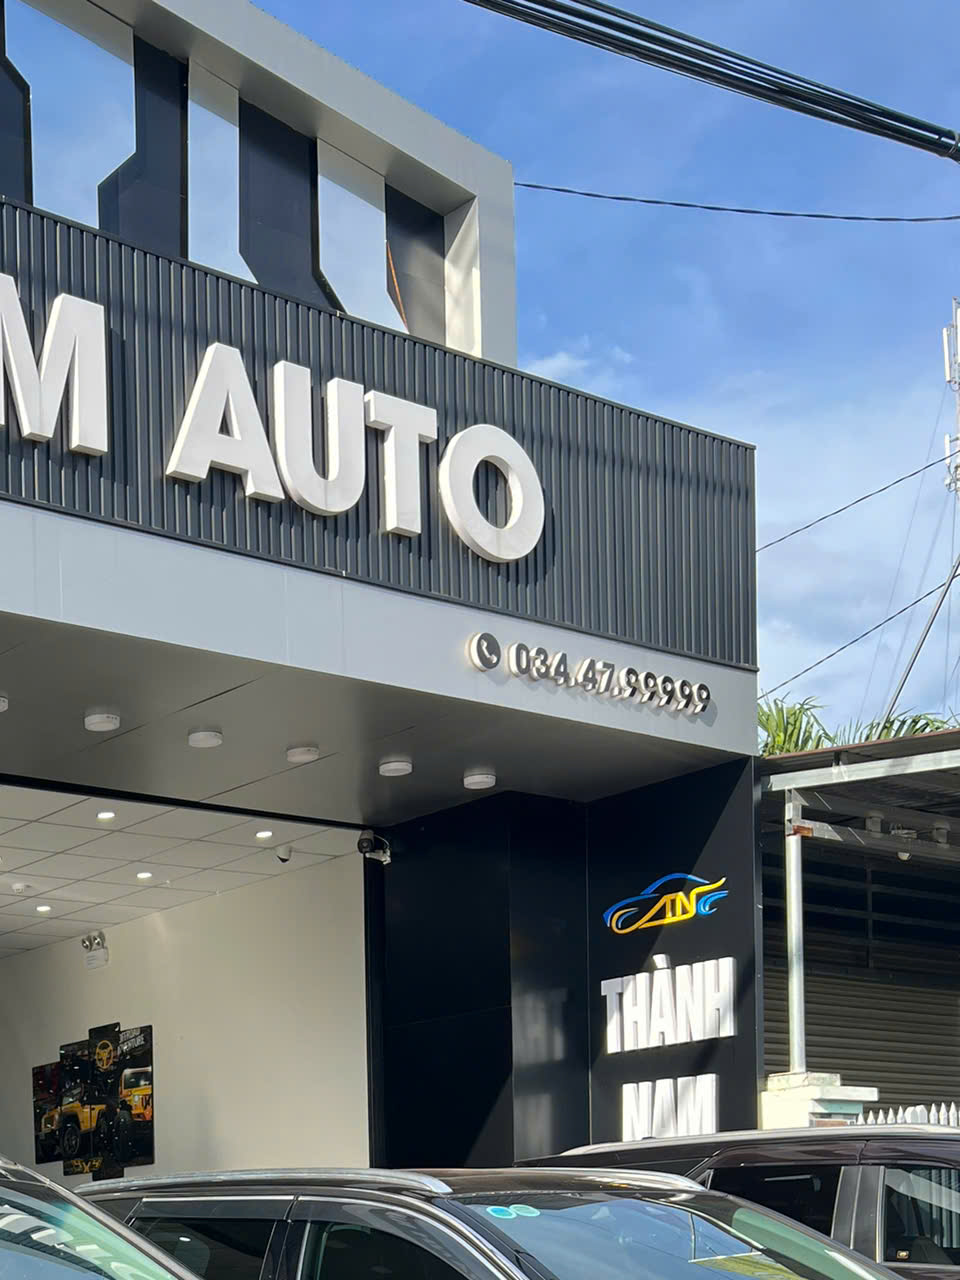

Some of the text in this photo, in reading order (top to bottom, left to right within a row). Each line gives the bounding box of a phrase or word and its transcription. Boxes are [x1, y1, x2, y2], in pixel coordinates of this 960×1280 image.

[165, 341, 546, 564] AUTO
[509, 642, 711, 714] 034.47.99999
[600, 953, 738, 1054] THÀNH
[622, 1073, 720, 1142] NAM
